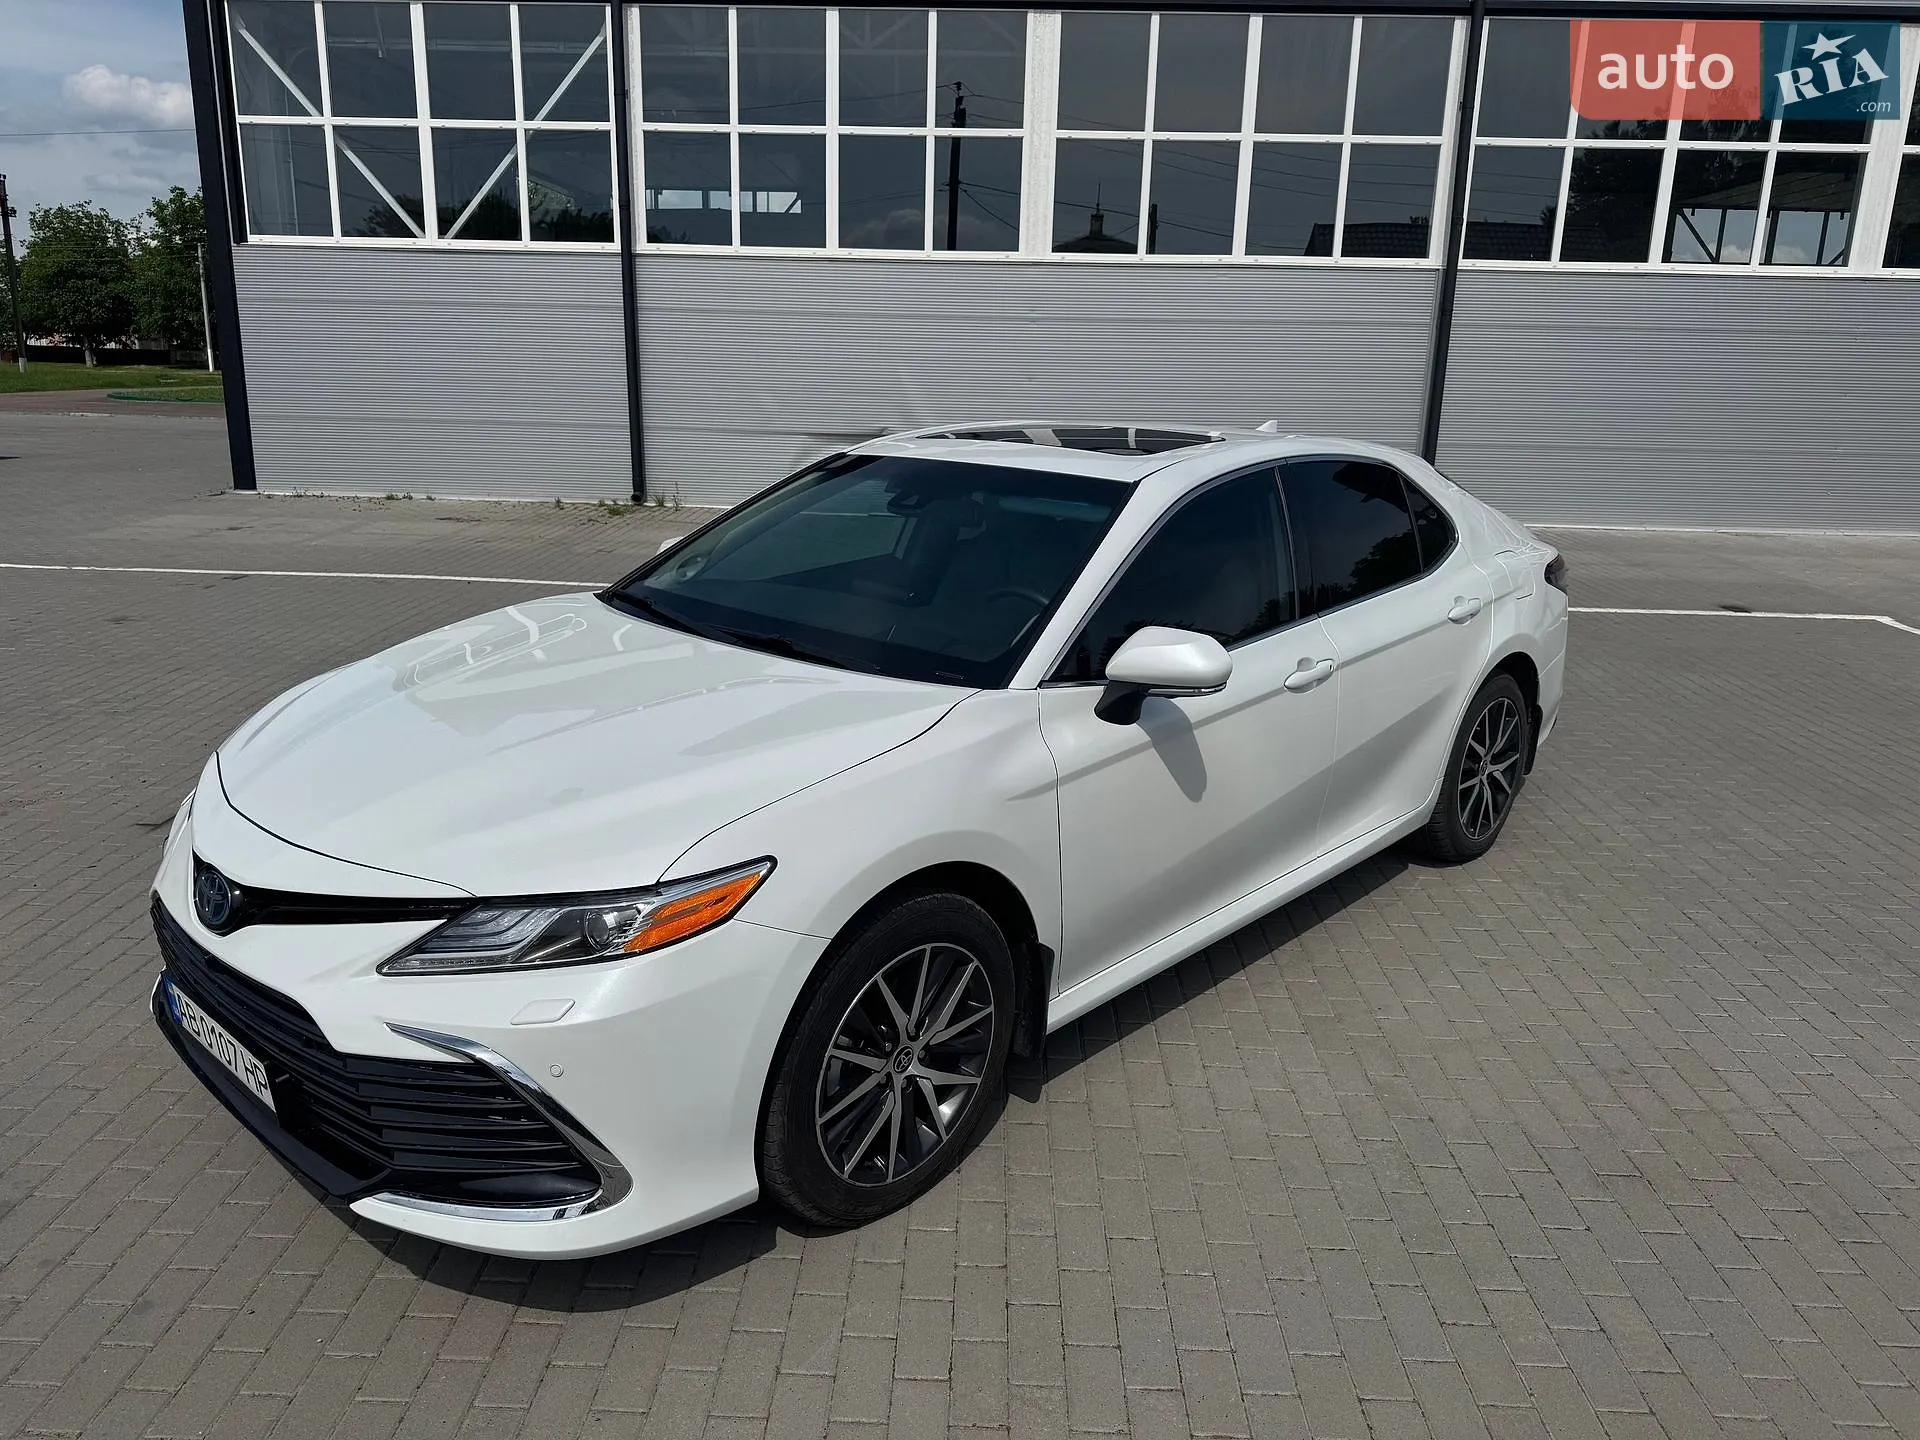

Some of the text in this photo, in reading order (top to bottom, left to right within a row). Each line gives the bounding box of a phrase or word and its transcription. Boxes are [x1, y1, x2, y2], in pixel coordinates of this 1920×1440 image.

[177, 992, 268, 1096] AB 0107 HP
